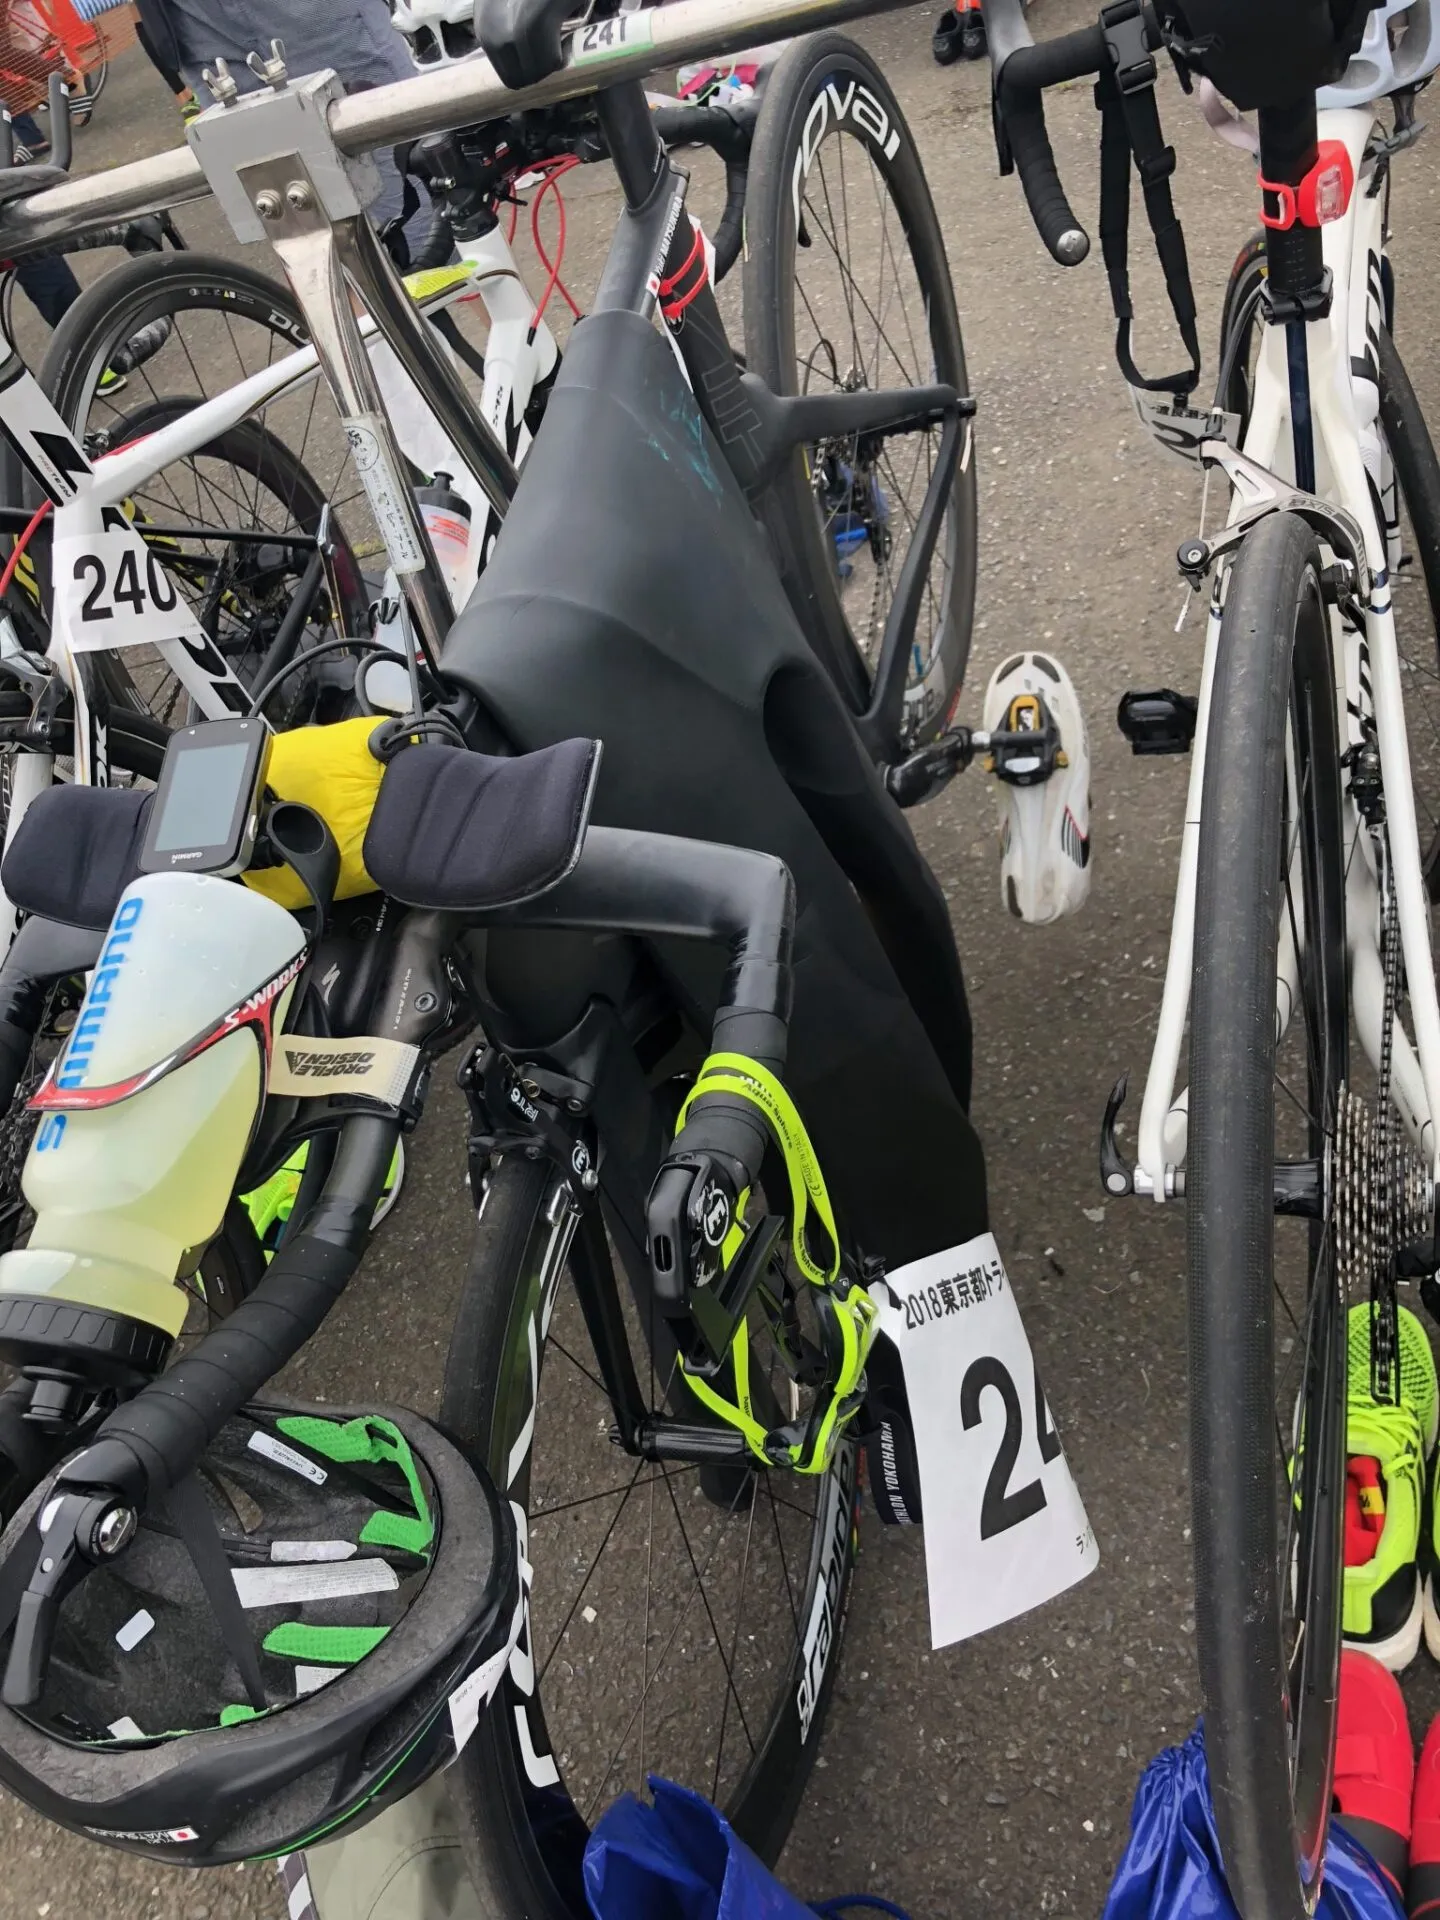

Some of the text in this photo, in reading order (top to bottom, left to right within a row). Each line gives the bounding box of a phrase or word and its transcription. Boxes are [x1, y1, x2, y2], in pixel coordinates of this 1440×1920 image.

[583, 15, 627, 52] 241
[73, 549, 177, 622] 240
[171, 852, 203, 864] GARMIN
[224, 946, 308, 1033] S-WORKS
[292, 1063, 375, 1077] PROFILE
[302, 1051, 377, 1065] DESIGN
[511, 1087, 539, 1122] RT6
[773, 1103, 793, 1150] Sphere
[880, 1421, 901, 1491] YOKOHAMA
